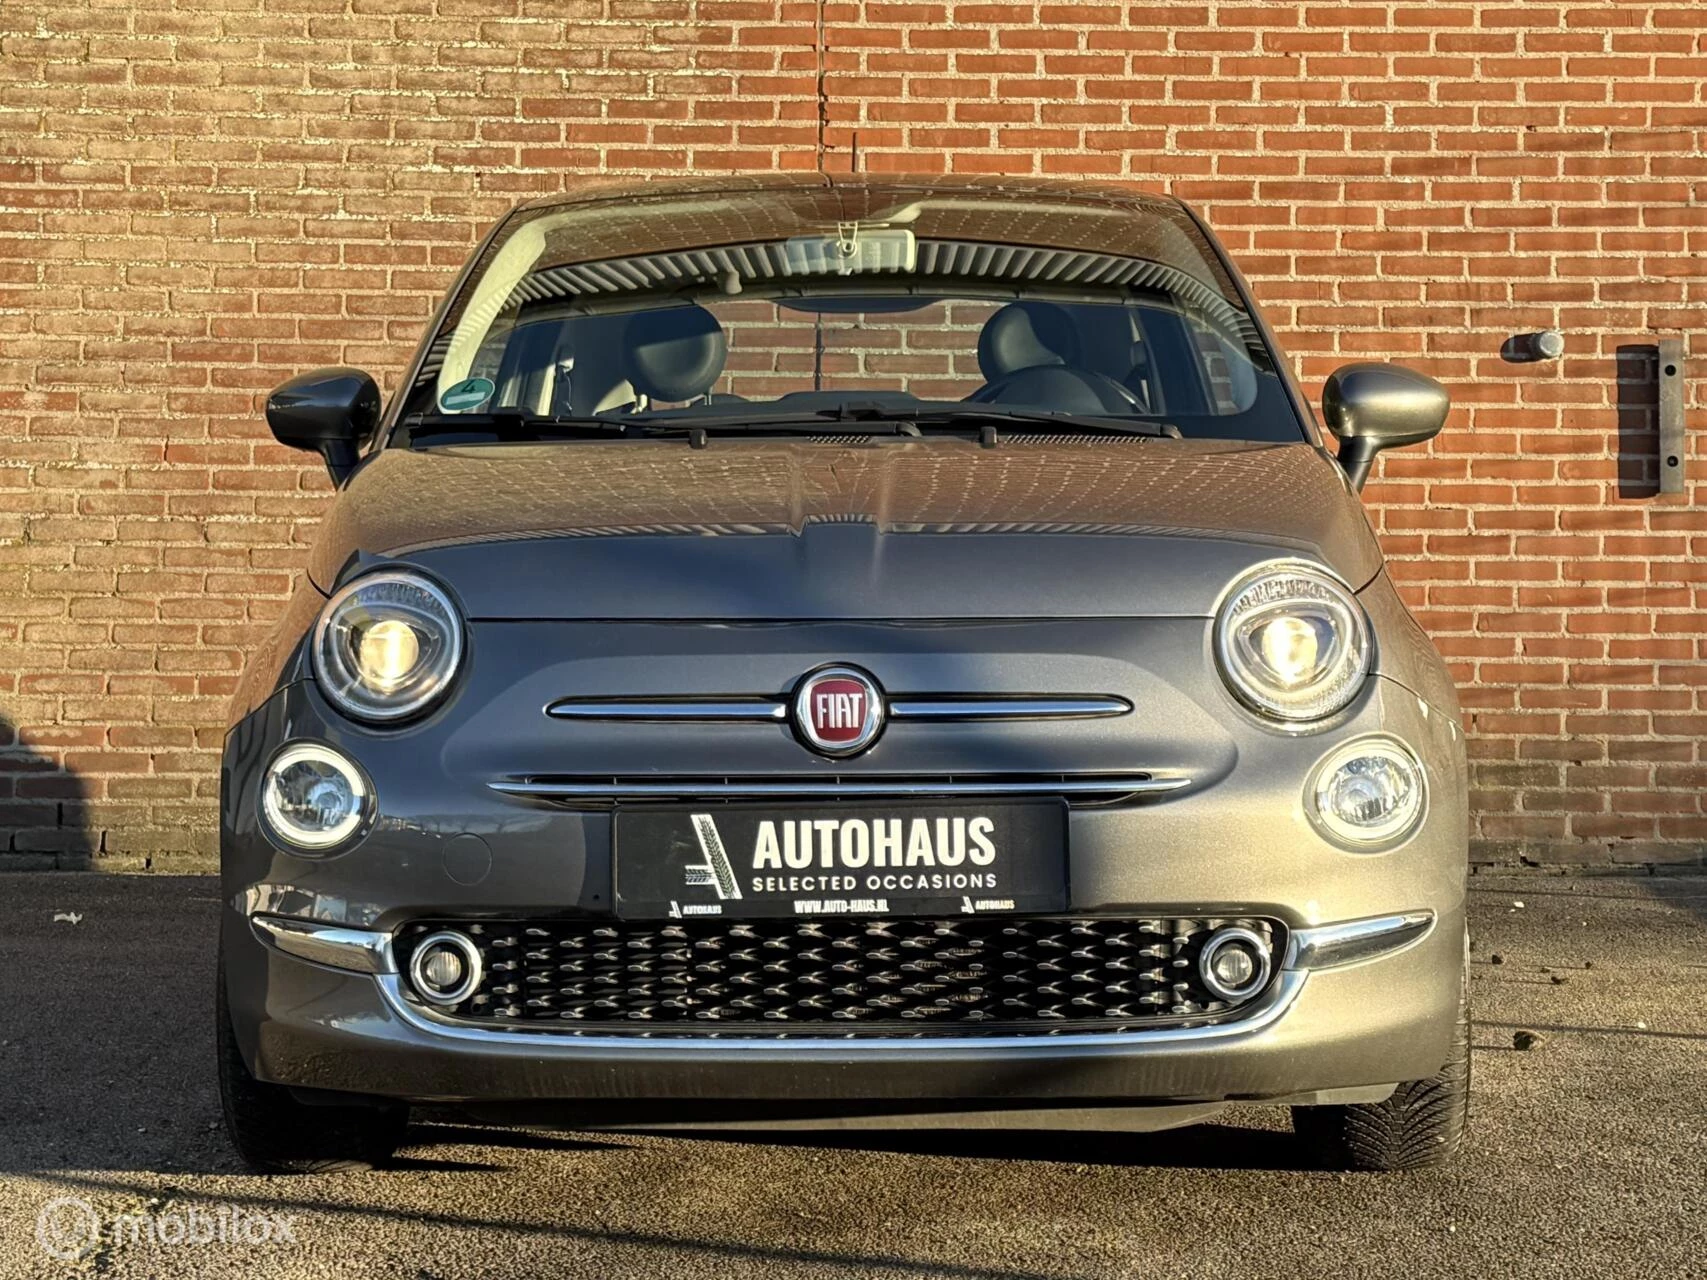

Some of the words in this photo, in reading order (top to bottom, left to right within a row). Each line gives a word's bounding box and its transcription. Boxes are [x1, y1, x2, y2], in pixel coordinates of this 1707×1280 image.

[816, 693, 862, 729] FIAT
[752, 817, 996, 869] AUTOHAUS
[752, 875, 857, 892] SELECTED
[866, 873, 997, 890] OCCASIONS
[793, 899, 890, 914] WWW.AUTO-HAUS.NL
